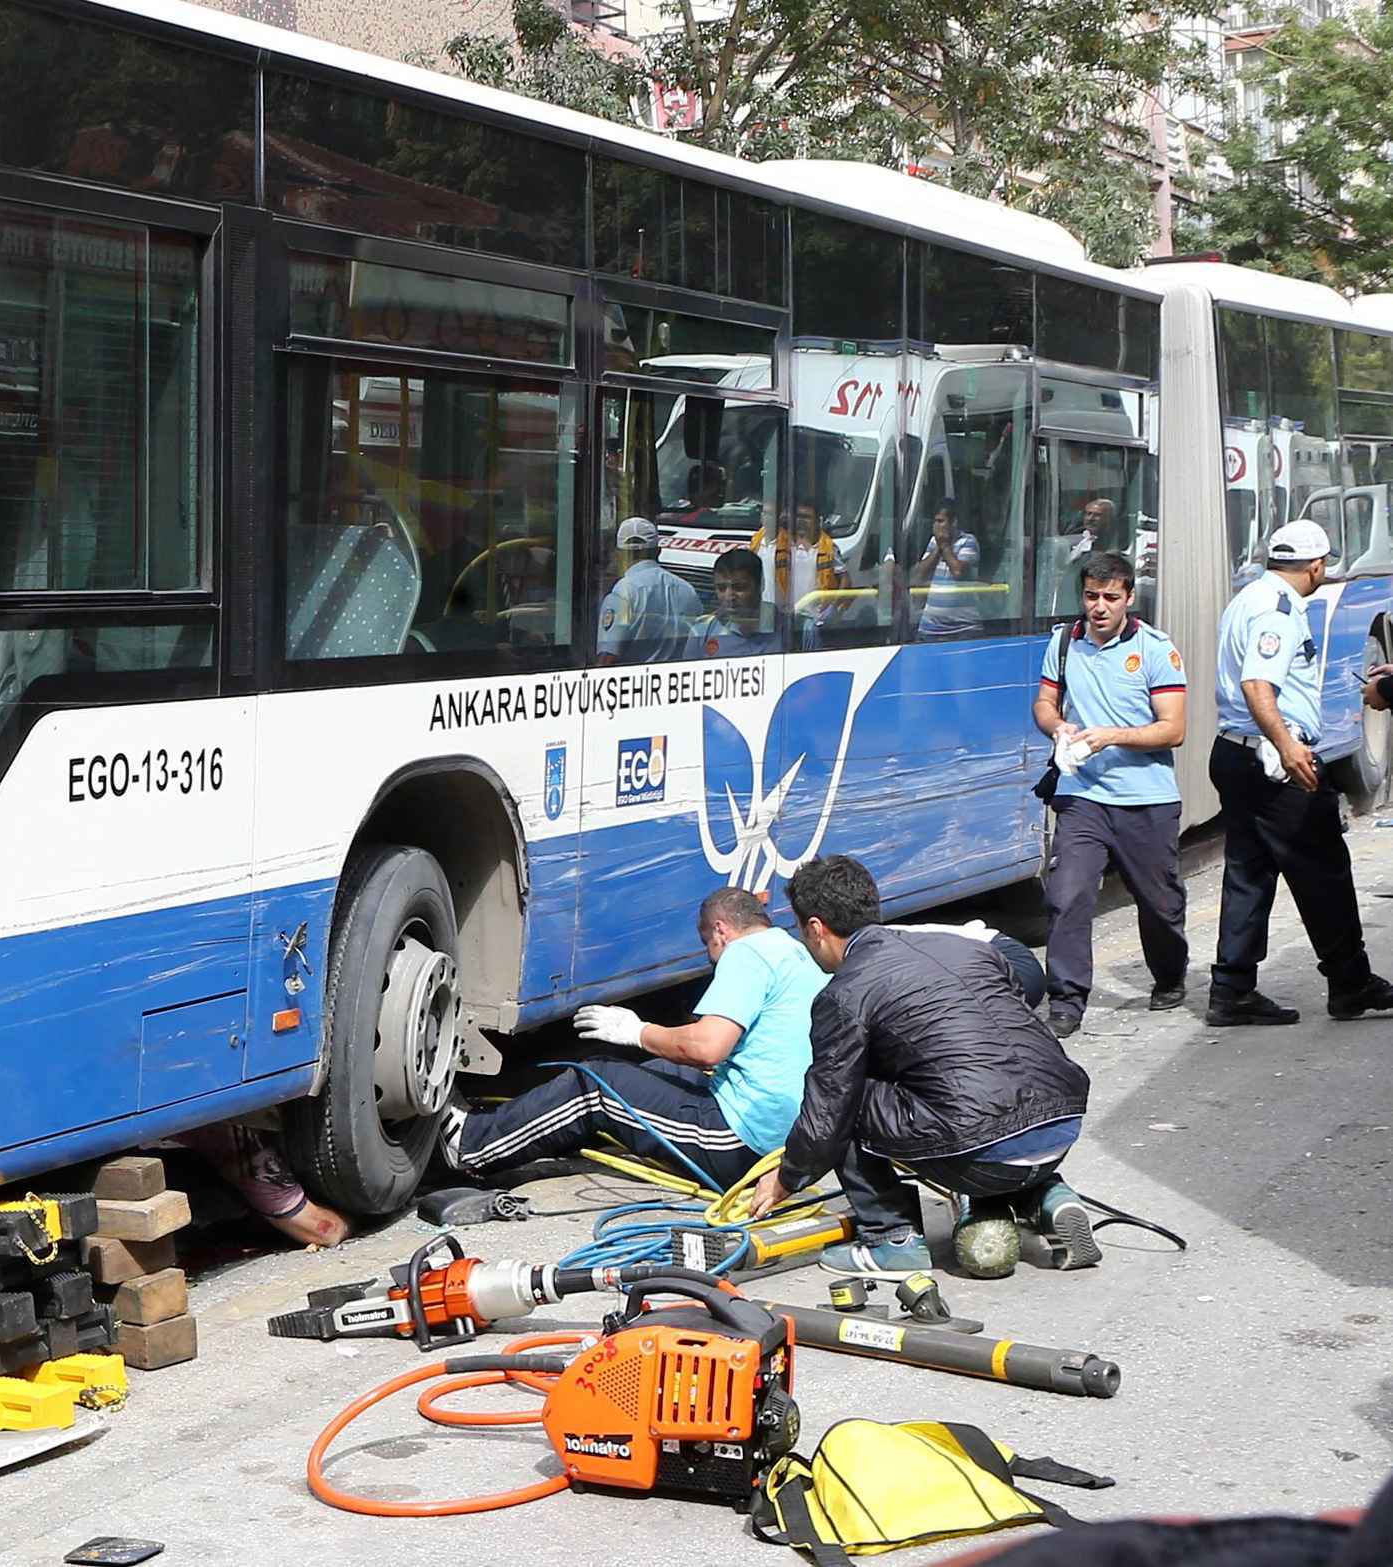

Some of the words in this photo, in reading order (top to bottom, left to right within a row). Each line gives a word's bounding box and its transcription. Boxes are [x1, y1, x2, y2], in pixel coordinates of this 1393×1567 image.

[429, 686, 527, 731] ANKARA
[534, 667, 662, 719] BÜYÜKŞEHİR
[667, 659, 766, 705] BELEDİYESİ
[69, 747, 223, 802] EGO-13-316
[619, 750, 665, 792] EGO
[345, 1311, 388, 1324] holmatro
